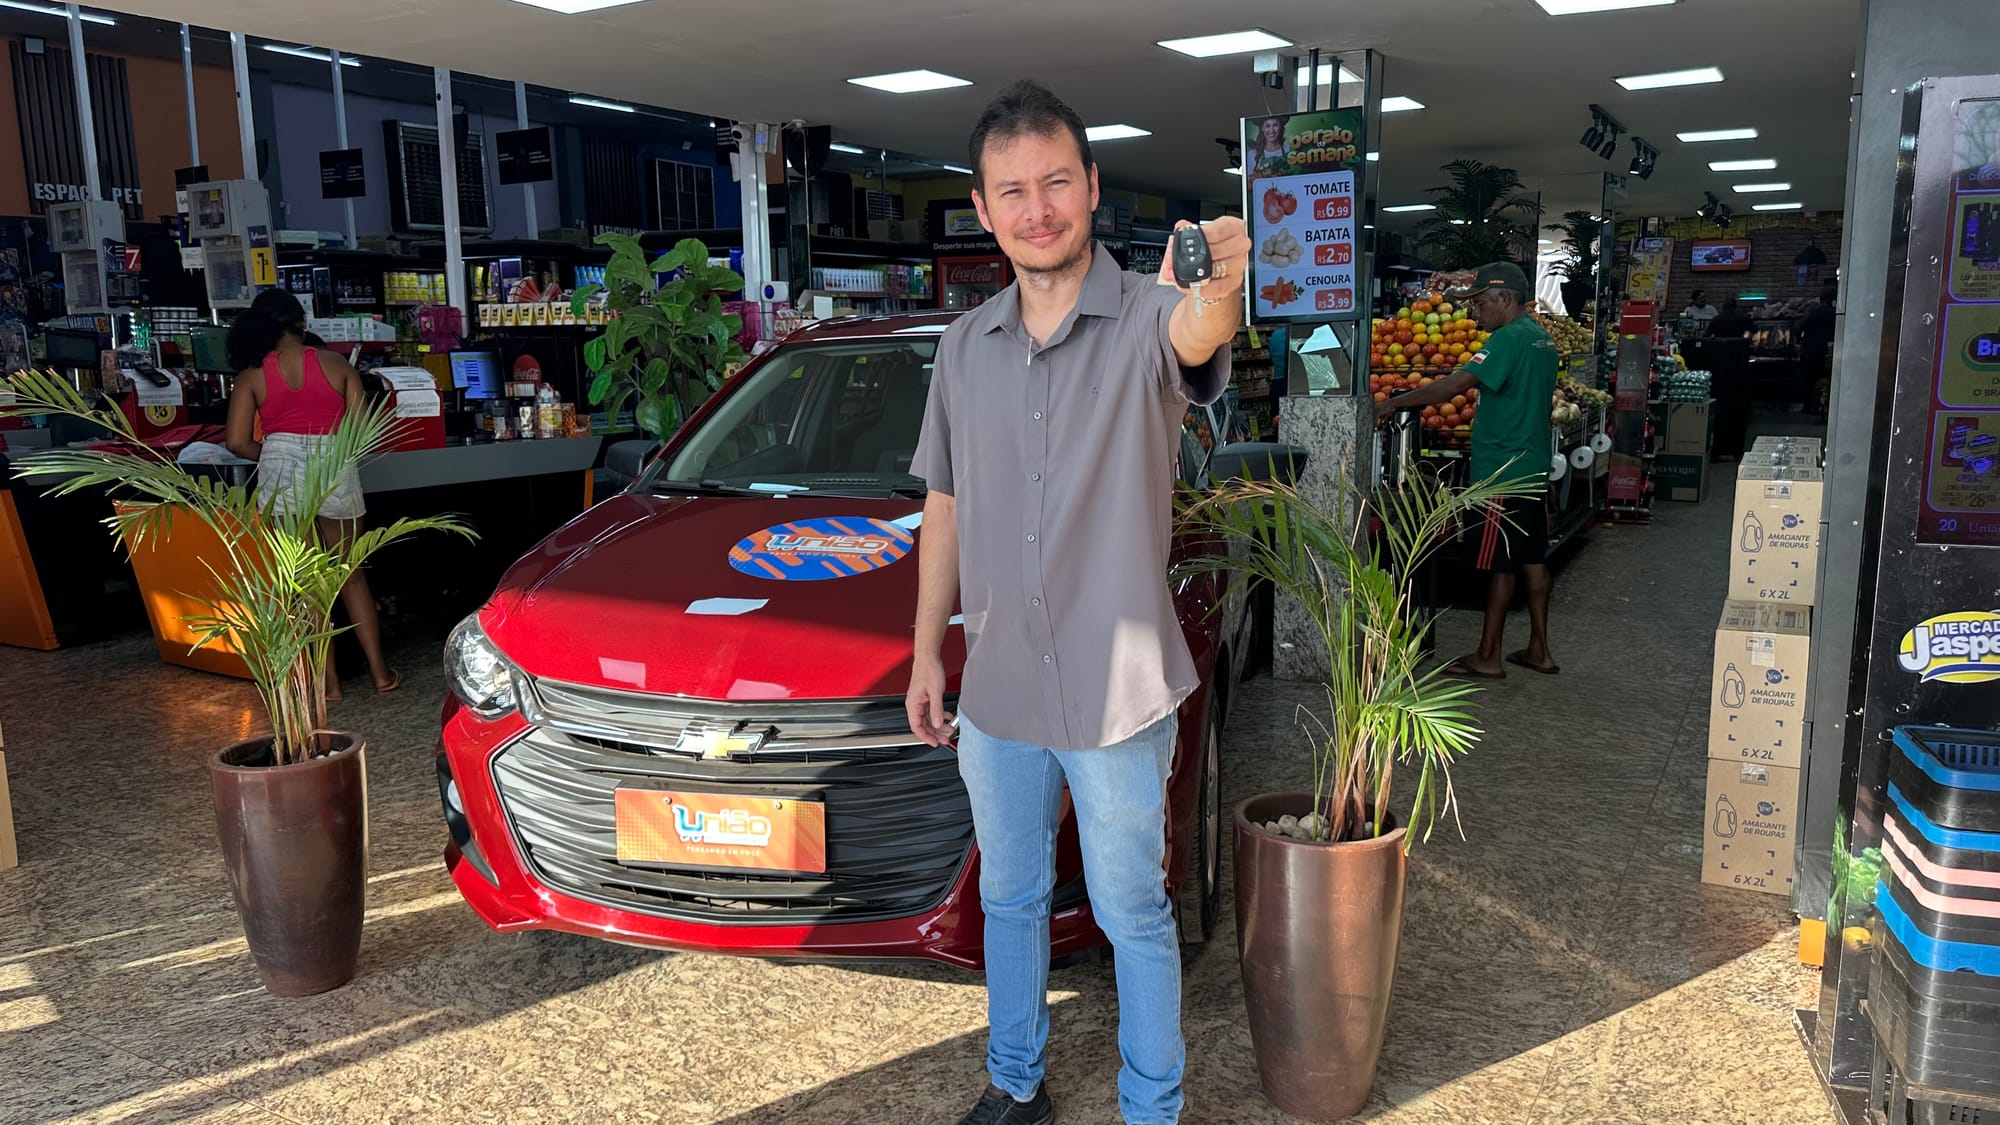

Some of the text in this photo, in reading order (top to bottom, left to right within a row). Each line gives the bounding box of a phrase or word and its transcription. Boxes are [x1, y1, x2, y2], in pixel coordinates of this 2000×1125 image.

[1287, 144, 1356, 165] semana
[33, 183, 143, 205] ESPAC PET
[1304, 181, 1350, 196] TOMATE
[1305, 228, 1350, 243] BATATA
[933, 242, 963, 250] Desperte
[975, 241, 997, 250] magia
[1305, 274, 1350, 286] CENOURA
[1939, 519, 1958, 532] 20
[1767, 533, 1810, 542] AMACIANTE
[1780, 541, 1809, 549] ROUPAS
[1760, 589, 1767, 598] 6
[1778, 591, 1790, 600] 2L
[1750, 688, 1796, 699] AMACIANTE
[1751, 696, 1796, 707] DE ROUPAS
[1741, 748, 1749, 757] 6
[1761, 750, 1775, 760] 2L
[1742, 819, 1788, 831] AMACIANTE
[1743, 827, 1786, 839] DE ROUPAS
[1734, 874, 1741, 884] 6
[1753, 876, 1767, 887] 2L
